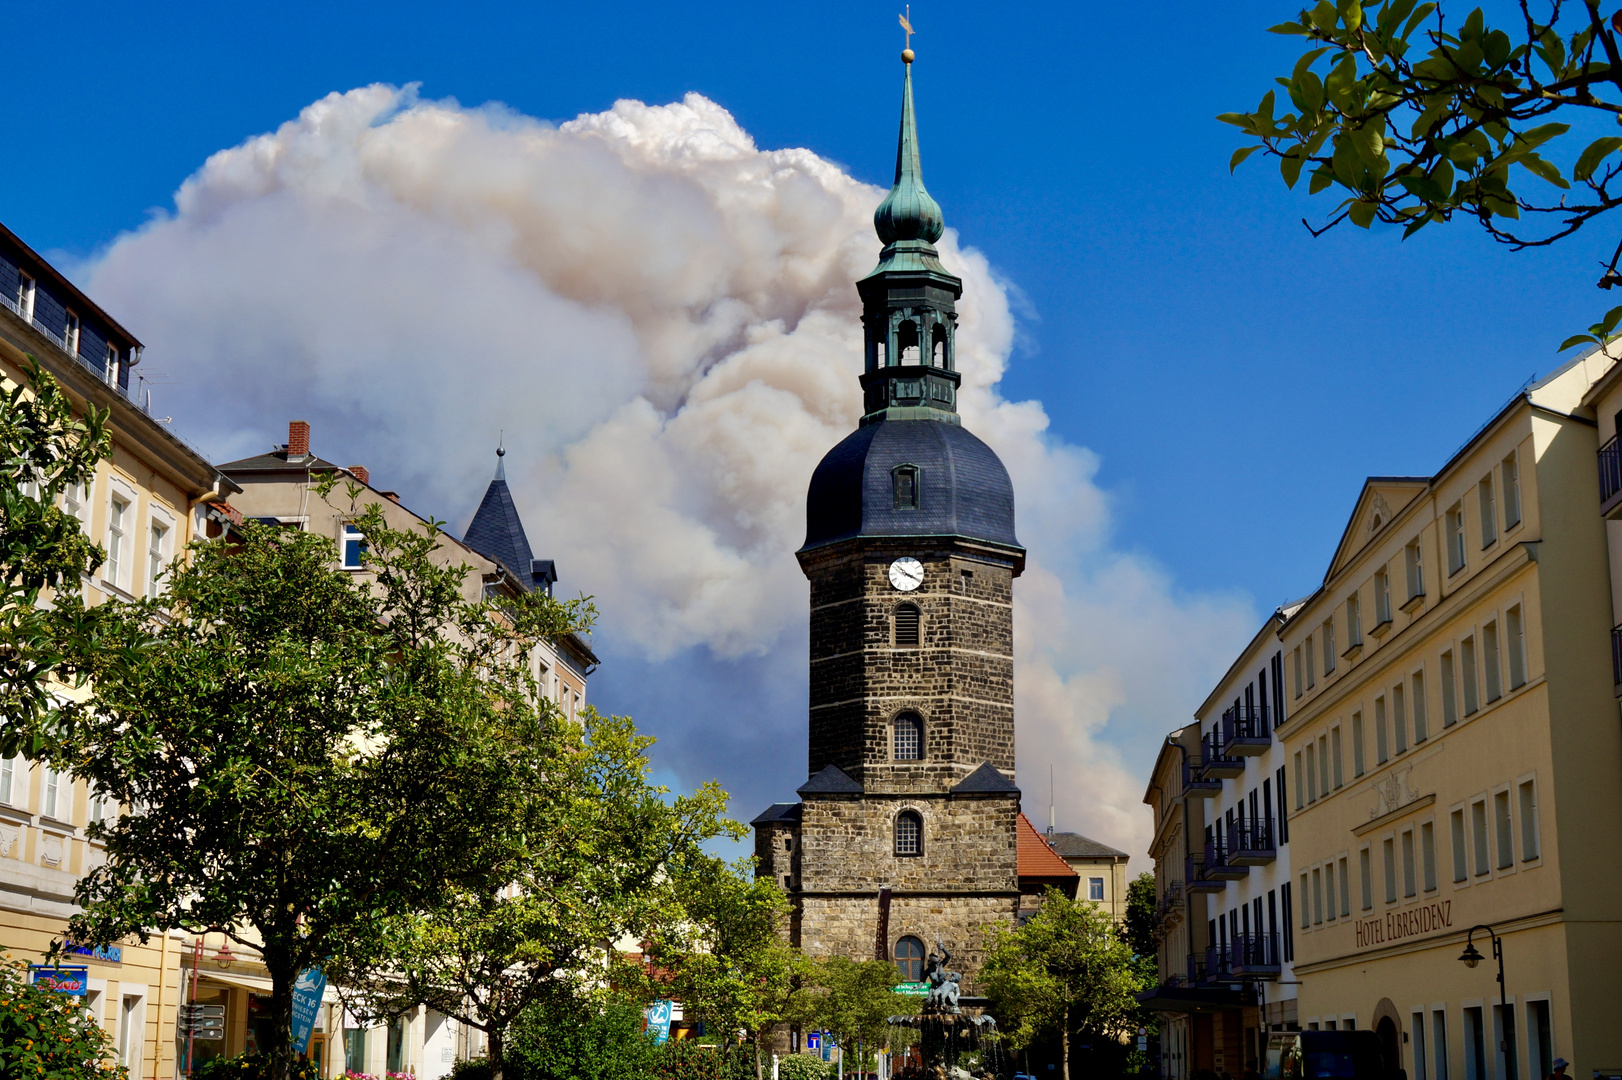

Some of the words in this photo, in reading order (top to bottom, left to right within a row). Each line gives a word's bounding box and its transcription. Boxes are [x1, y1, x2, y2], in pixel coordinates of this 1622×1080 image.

[1355, 919, 1385, 948] HOTEL
[1386, 900, 1453, 941] ELBRESIDENZ
[292, 992, 307, 1005] ECK
[307, 998, 317, 1008] 16
